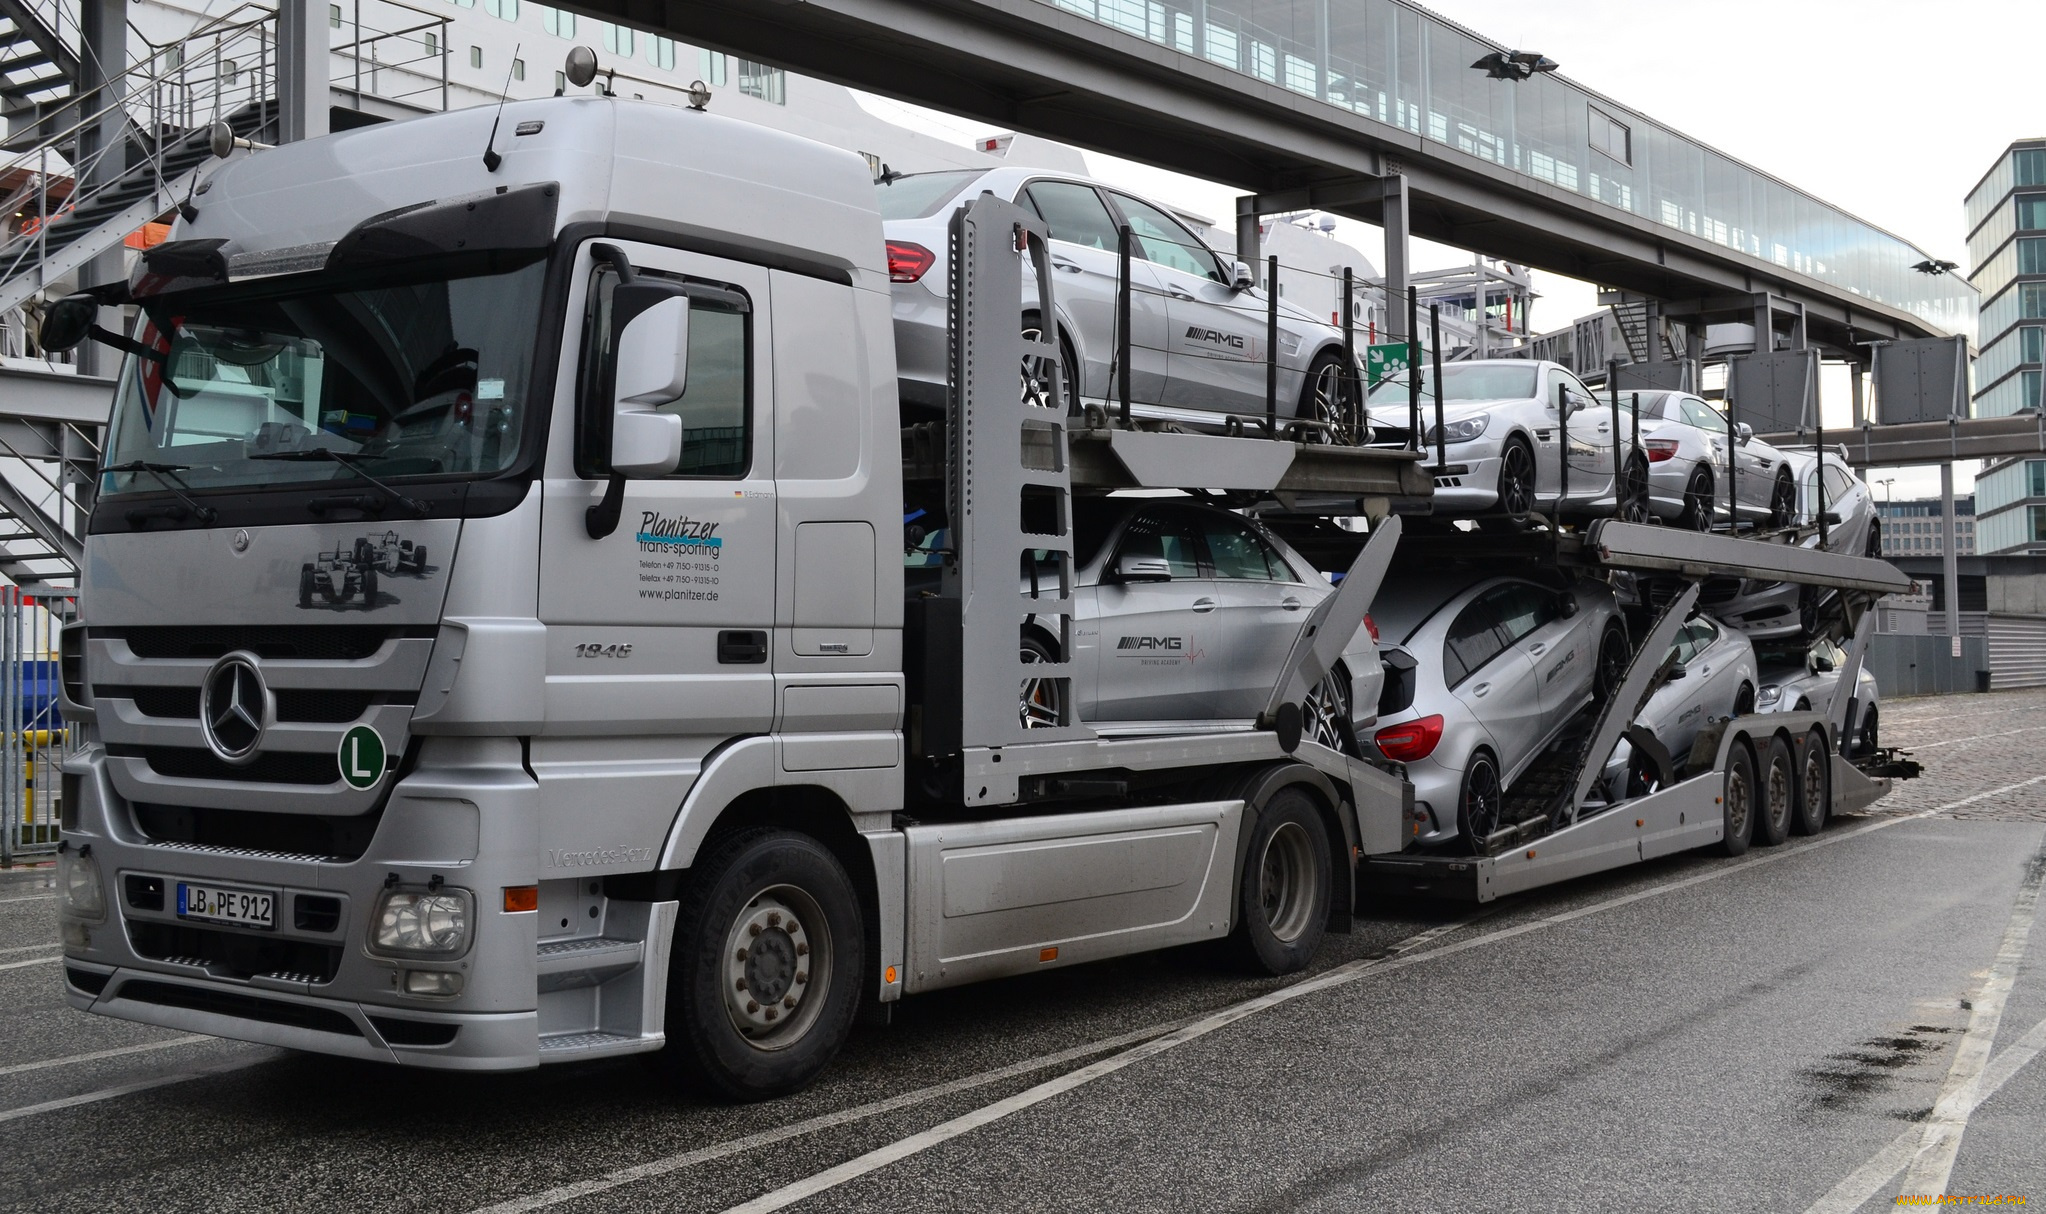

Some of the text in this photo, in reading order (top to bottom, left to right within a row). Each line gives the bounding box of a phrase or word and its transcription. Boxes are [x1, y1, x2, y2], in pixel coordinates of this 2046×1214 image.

[1203, 330, 1244, 349] AMG
[640, 511, 720, 540] Planitzer
[640, 538, 720, 560] trans-sporting
[639, 560, 662, 569] Telefon
[639, 573, 661, 583] Telefax
[663, 575, 674, 583] +49
[639, 589, 719, 601] www.planitzer.de
[575, 643, 633, 658] 1846
[1137, 637, 1182, 650] AMG
[352, 737, 371, 777] L
[547, 844, 652, 868] Mercedes-Benz
[187, 888, 271, 921] LB PE 912
